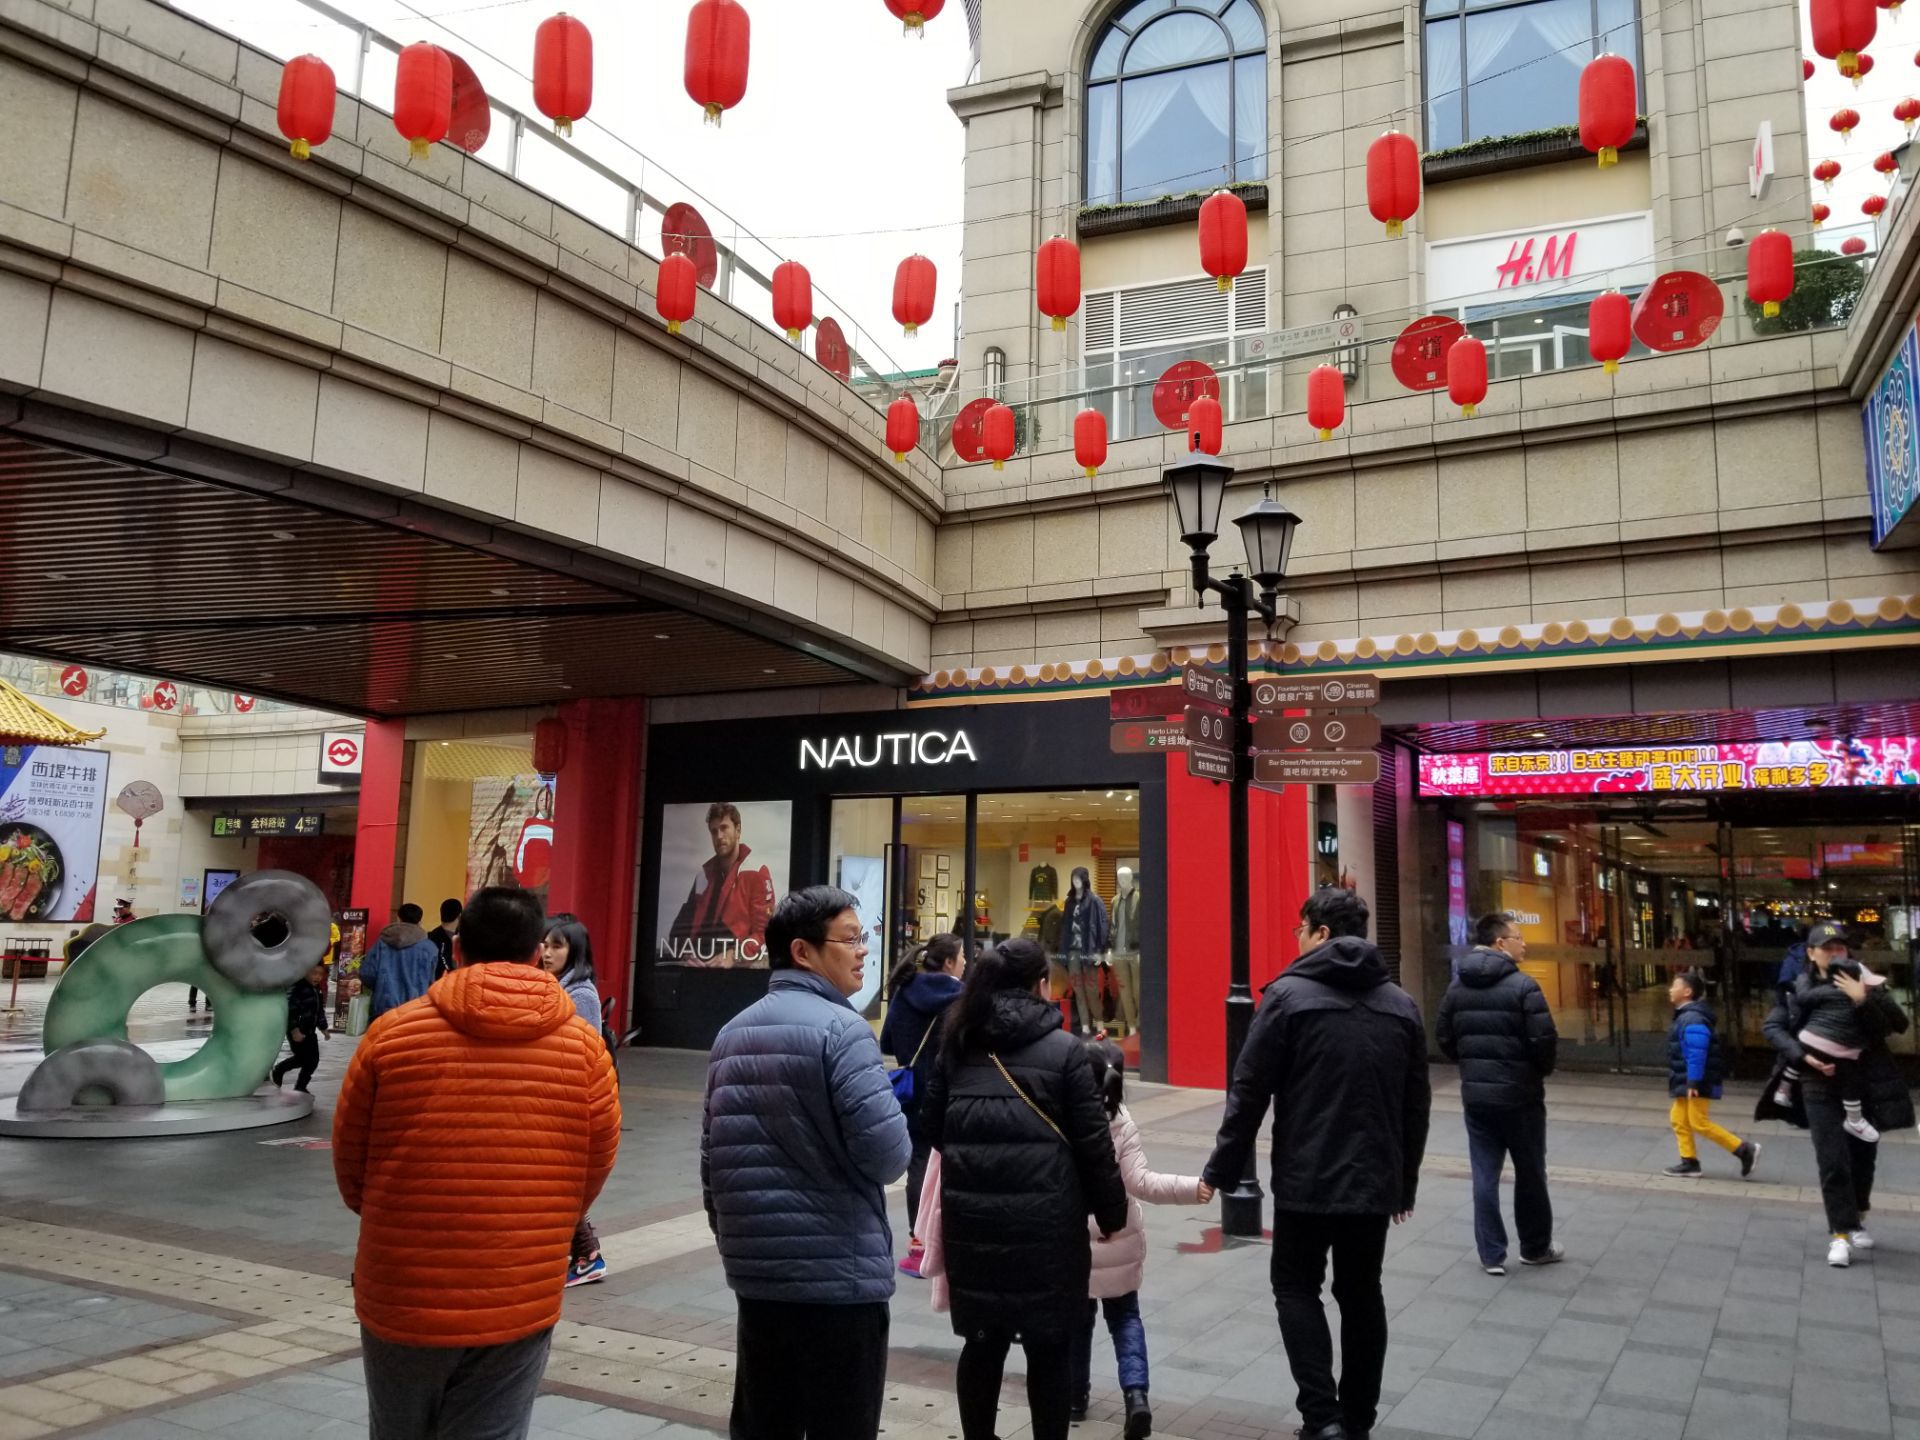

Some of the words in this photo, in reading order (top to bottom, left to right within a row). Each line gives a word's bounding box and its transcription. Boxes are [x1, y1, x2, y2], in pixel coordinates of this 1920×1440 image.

[1496, 231, 1577, 289] H&M
[1346, 689, 1375, 699] 电影院
[800, 730, 976, 769] NAUTICA
[32, 762, 97, 781] 西堤牛排
[1651, 763, 1744, 789] 盛大开业
[1753, 763, 1828, 786] 福利多多
[226, 818, 241, 829] 号线
[251, 817, 285, 829] 金科路站
[294, 817, 304, 833] 4
[304, 816, 318, 825] 号口
